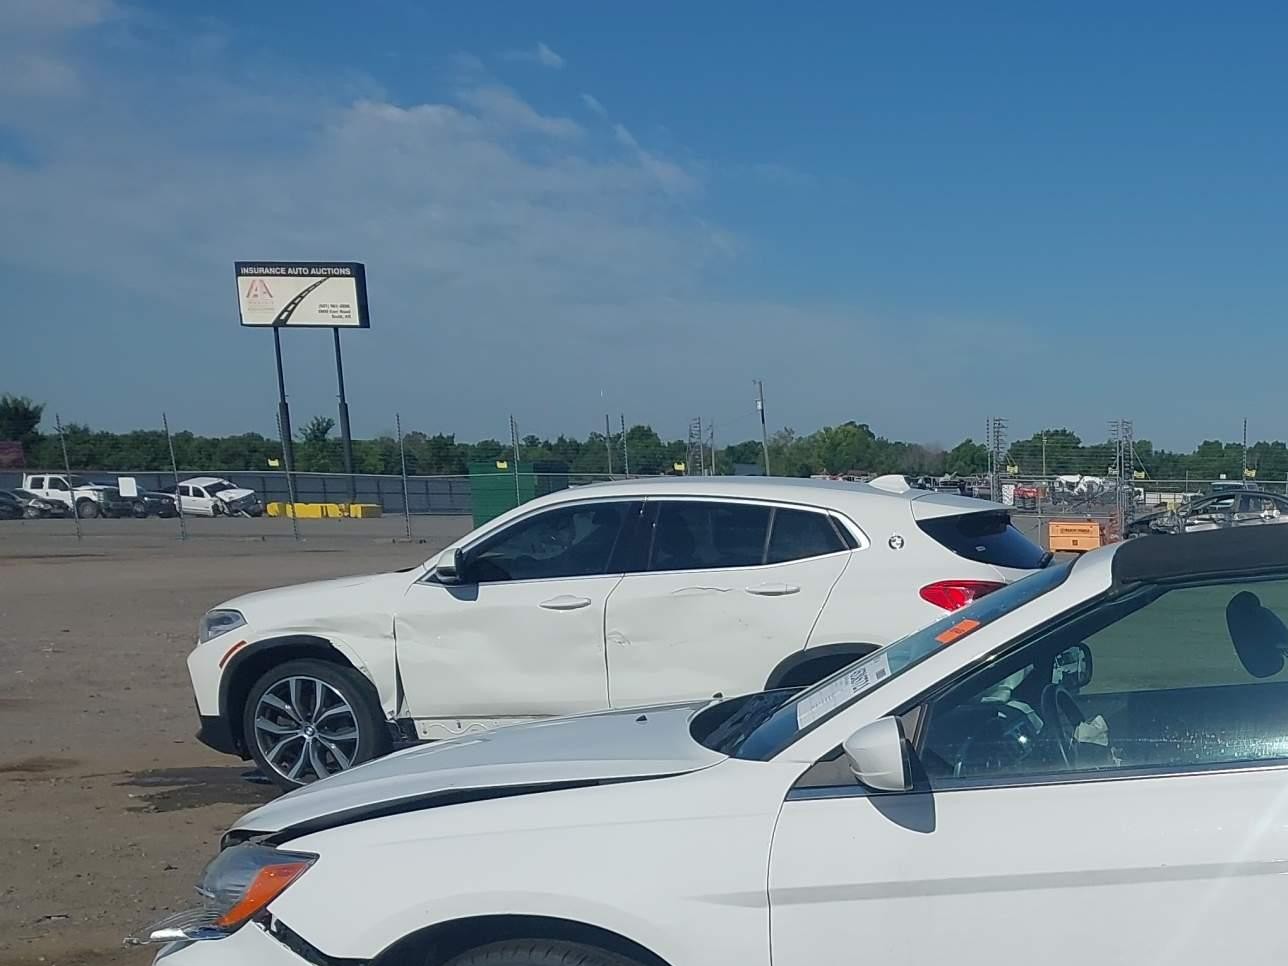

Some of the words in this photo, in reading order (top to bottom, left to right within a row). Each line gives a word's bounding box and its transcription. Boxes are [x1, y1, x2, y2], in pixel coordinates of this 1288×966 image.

[240, 267, 286, 275] INSURANCE
[287, 267, 309, 275] AUTO
[310, 267, 351, 275] AUCTIONS
